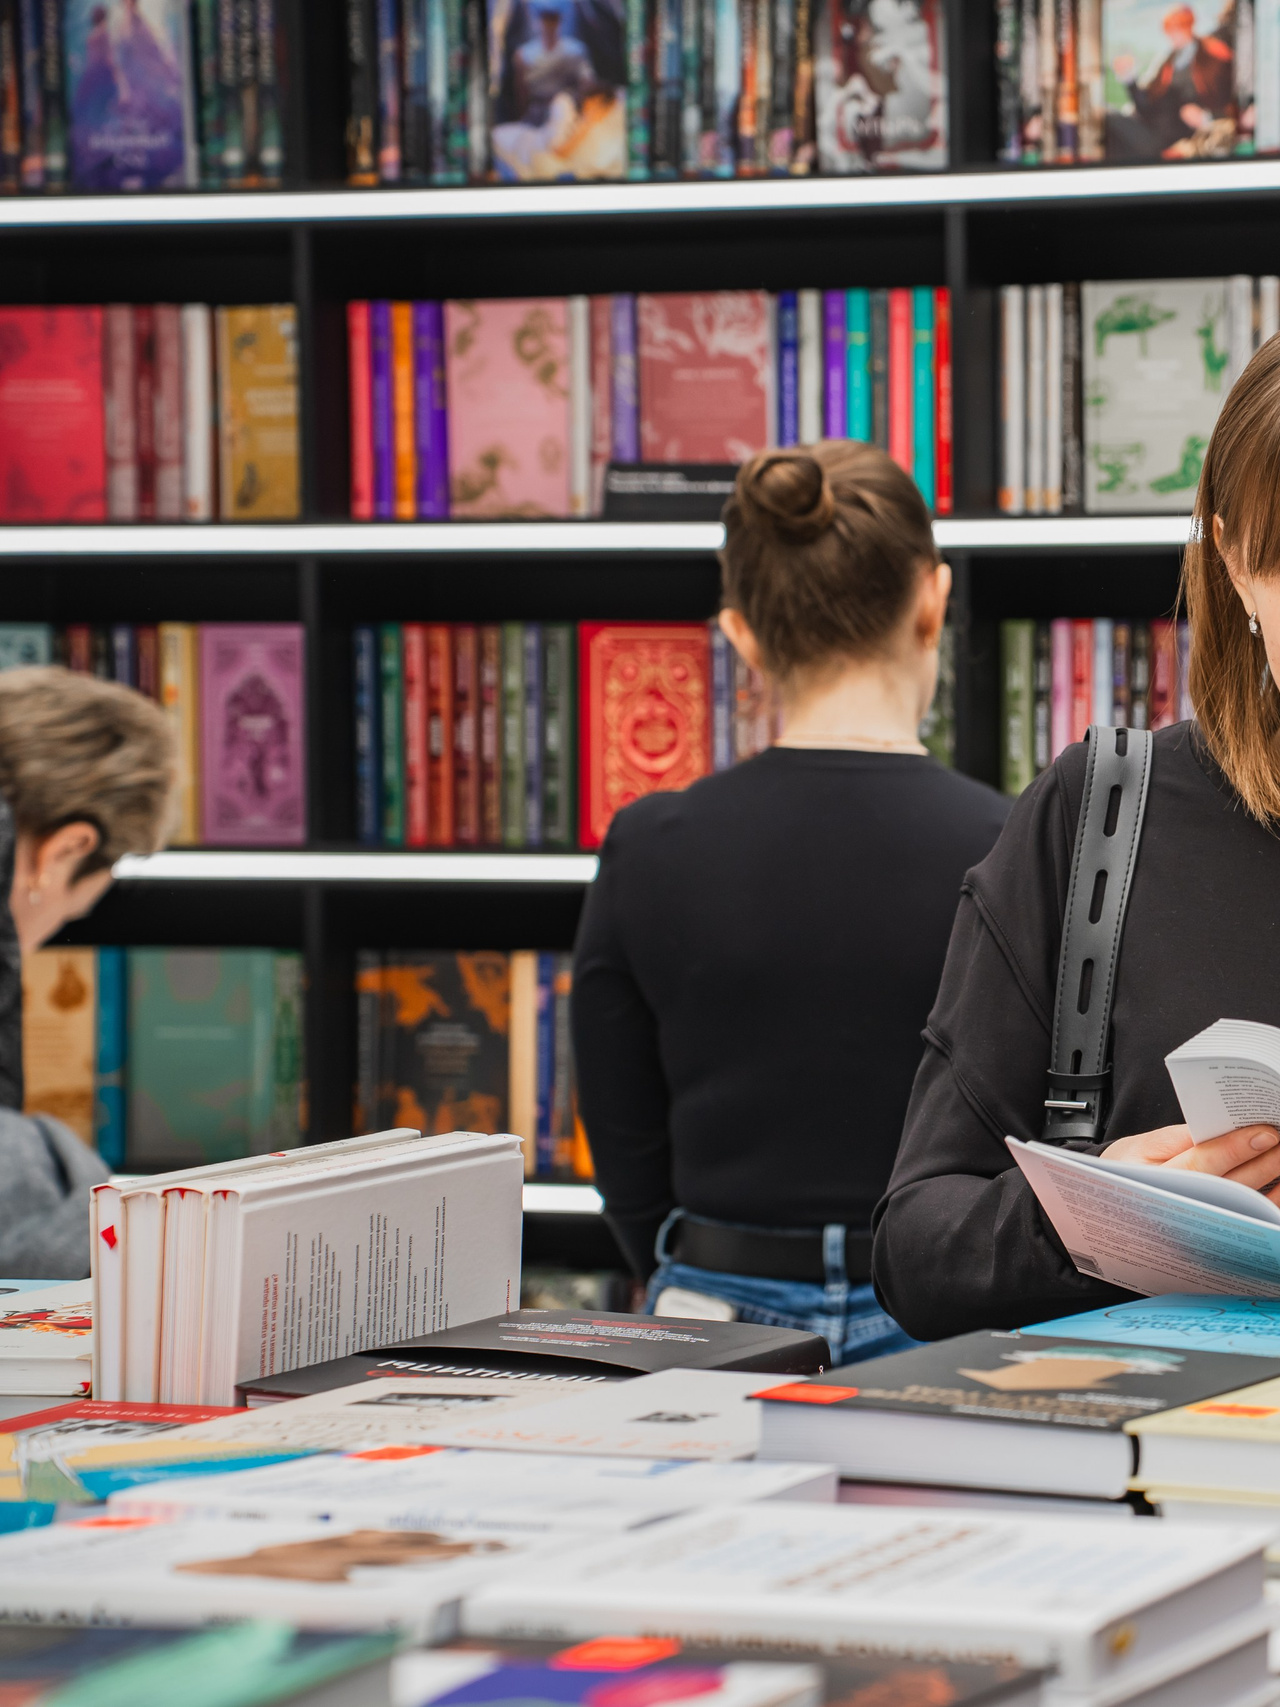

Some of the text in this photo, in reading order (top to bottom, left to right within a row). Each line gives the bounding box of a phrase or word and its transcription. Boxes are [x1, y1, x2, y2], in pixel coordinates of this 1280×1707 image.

[262, 1277, 270, 1306] продаж
[270, 1273, 278, 1309] подвиги?
[268, 1334, 276, 1374] охновлять
[376, 1359, 607, 1384] ПРИНЦИПЫ
